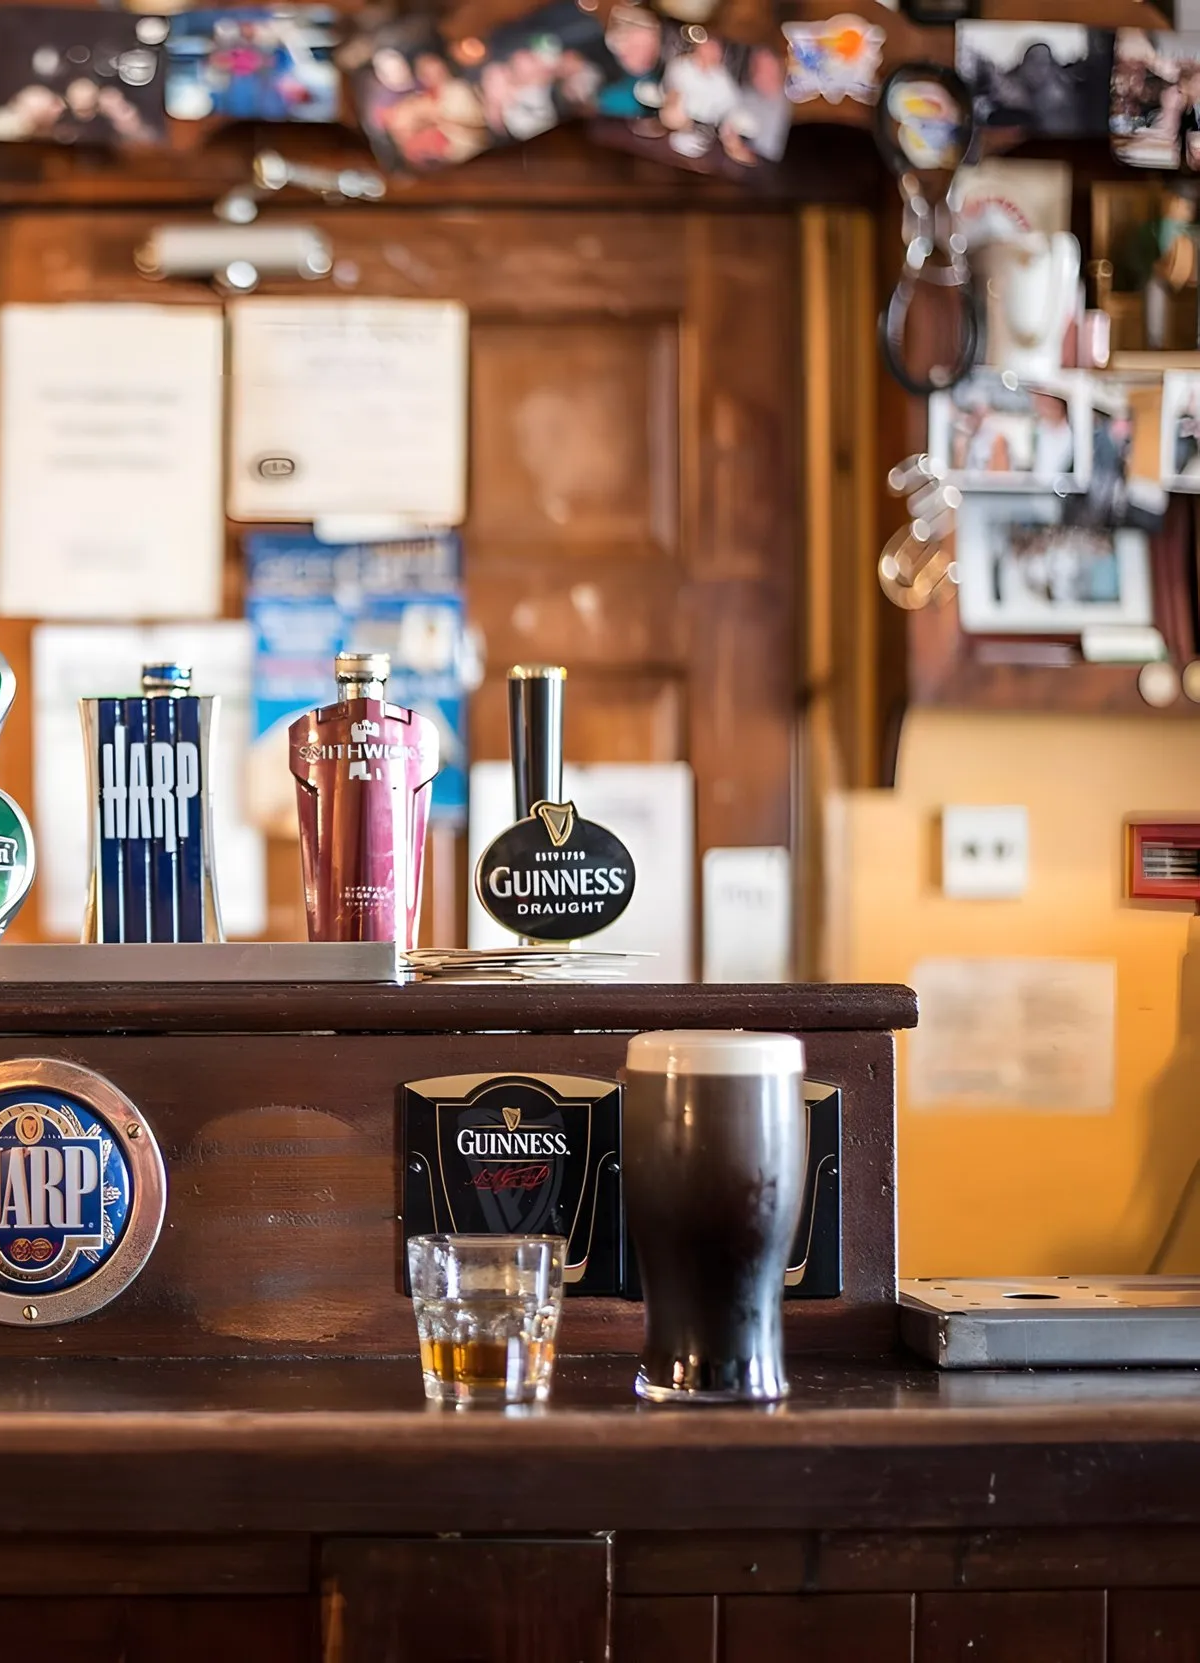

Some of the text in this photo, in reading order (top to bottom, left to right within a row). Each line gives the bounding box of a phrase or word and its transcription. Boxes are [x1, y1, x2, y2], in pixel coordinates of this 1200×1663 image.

[103, 725, 199, 853] HARP
[489, 866, 626, 898] GUINNESS
[517, 901, 605, 915] DRAUGHT
[457, 1129, 567, 1156] GUINNESS
